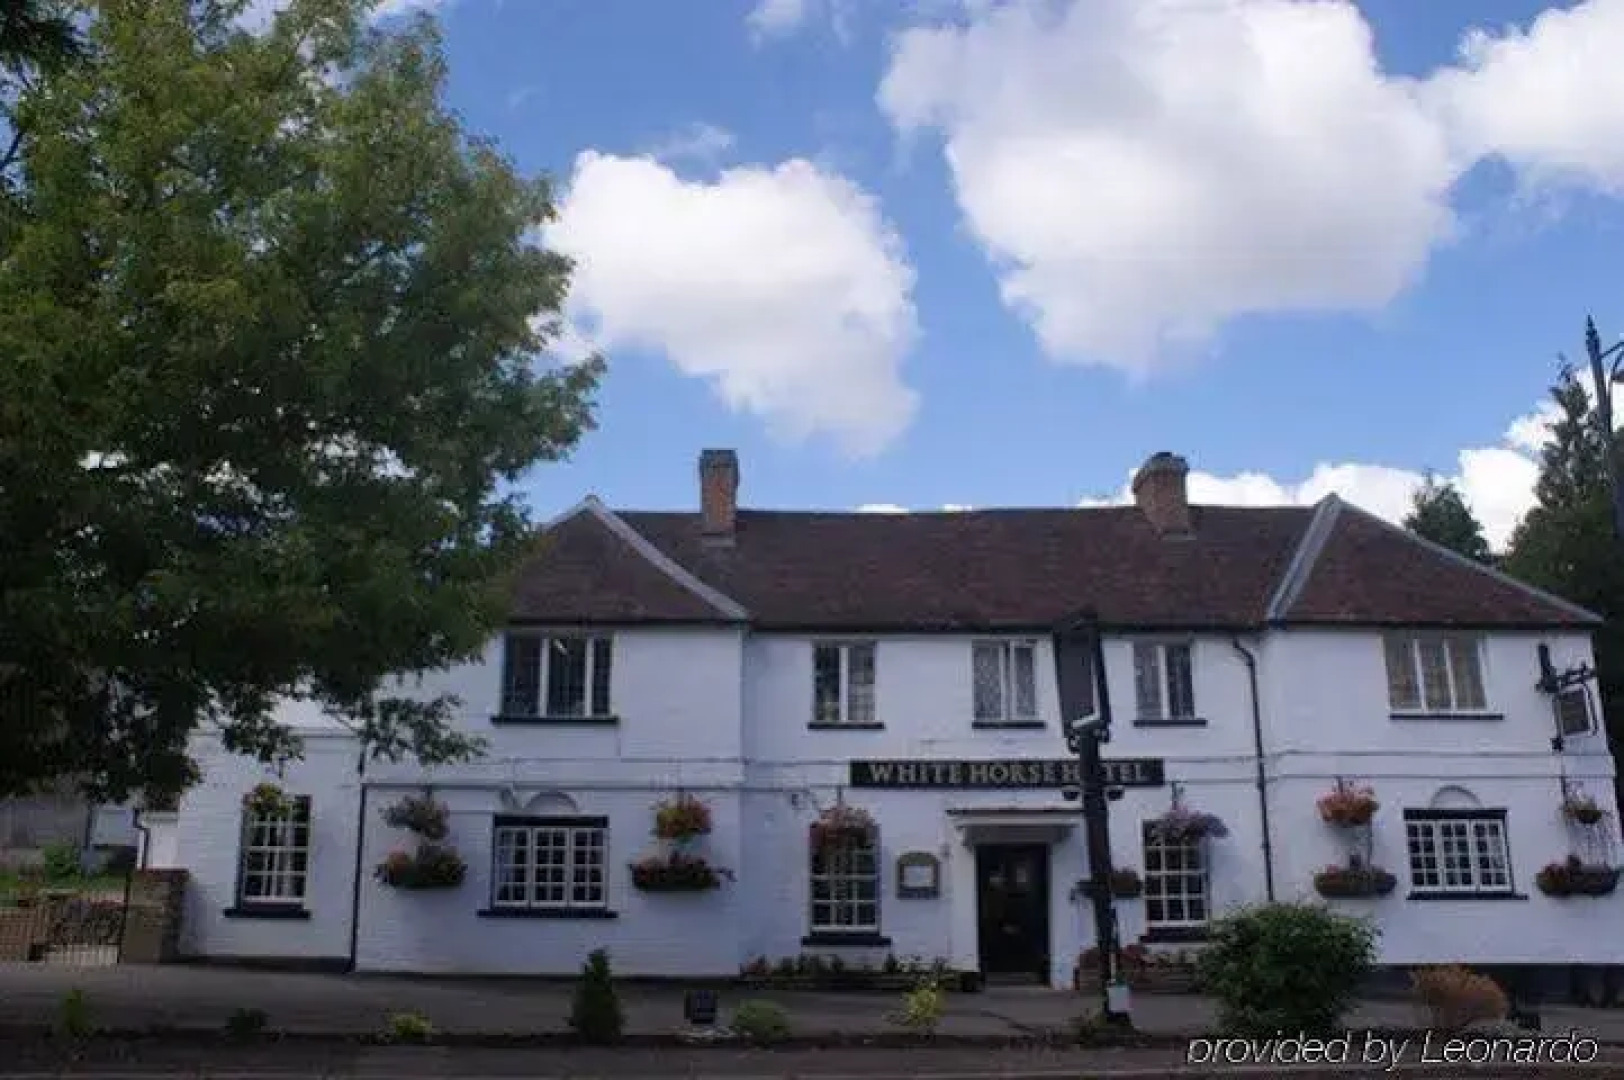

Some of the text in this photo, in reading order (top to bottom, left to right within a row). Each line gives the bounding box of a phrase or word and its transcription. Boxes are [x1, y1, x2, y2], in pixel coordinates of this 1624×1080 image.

[868, 761, 1149, 784] WHITE HORSE HTEL
